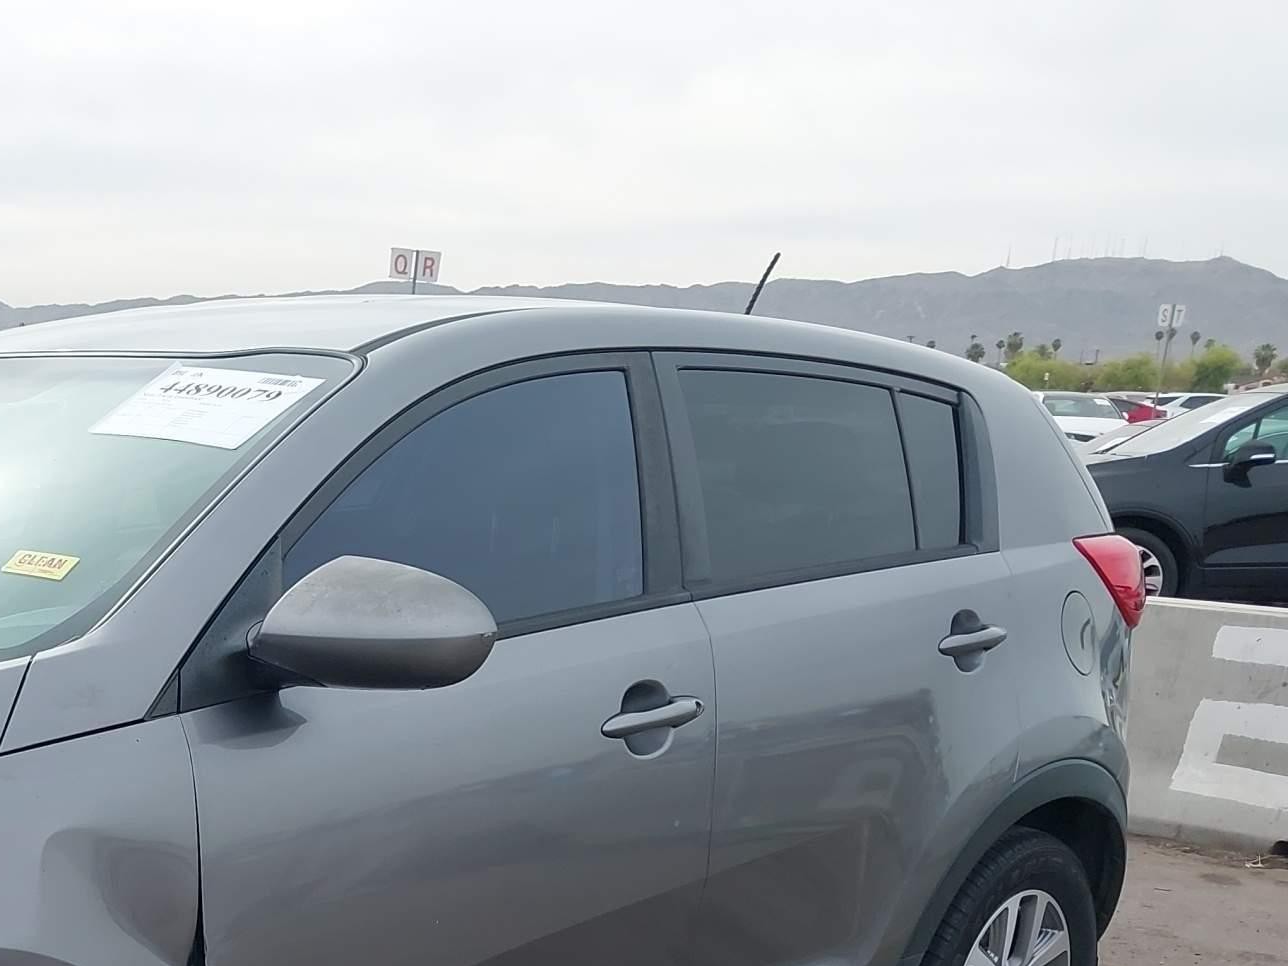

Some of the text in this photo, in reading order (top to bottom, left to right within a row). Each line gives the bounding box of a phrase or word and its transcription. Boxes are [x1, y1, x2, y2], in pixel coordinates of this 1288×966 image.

[394, 254, 435, 277] Q R
[1161, 308, 1169, 322] S
[159, 381, 283, 402] 44890079
[18, 554, 68, 569] CLEAN
